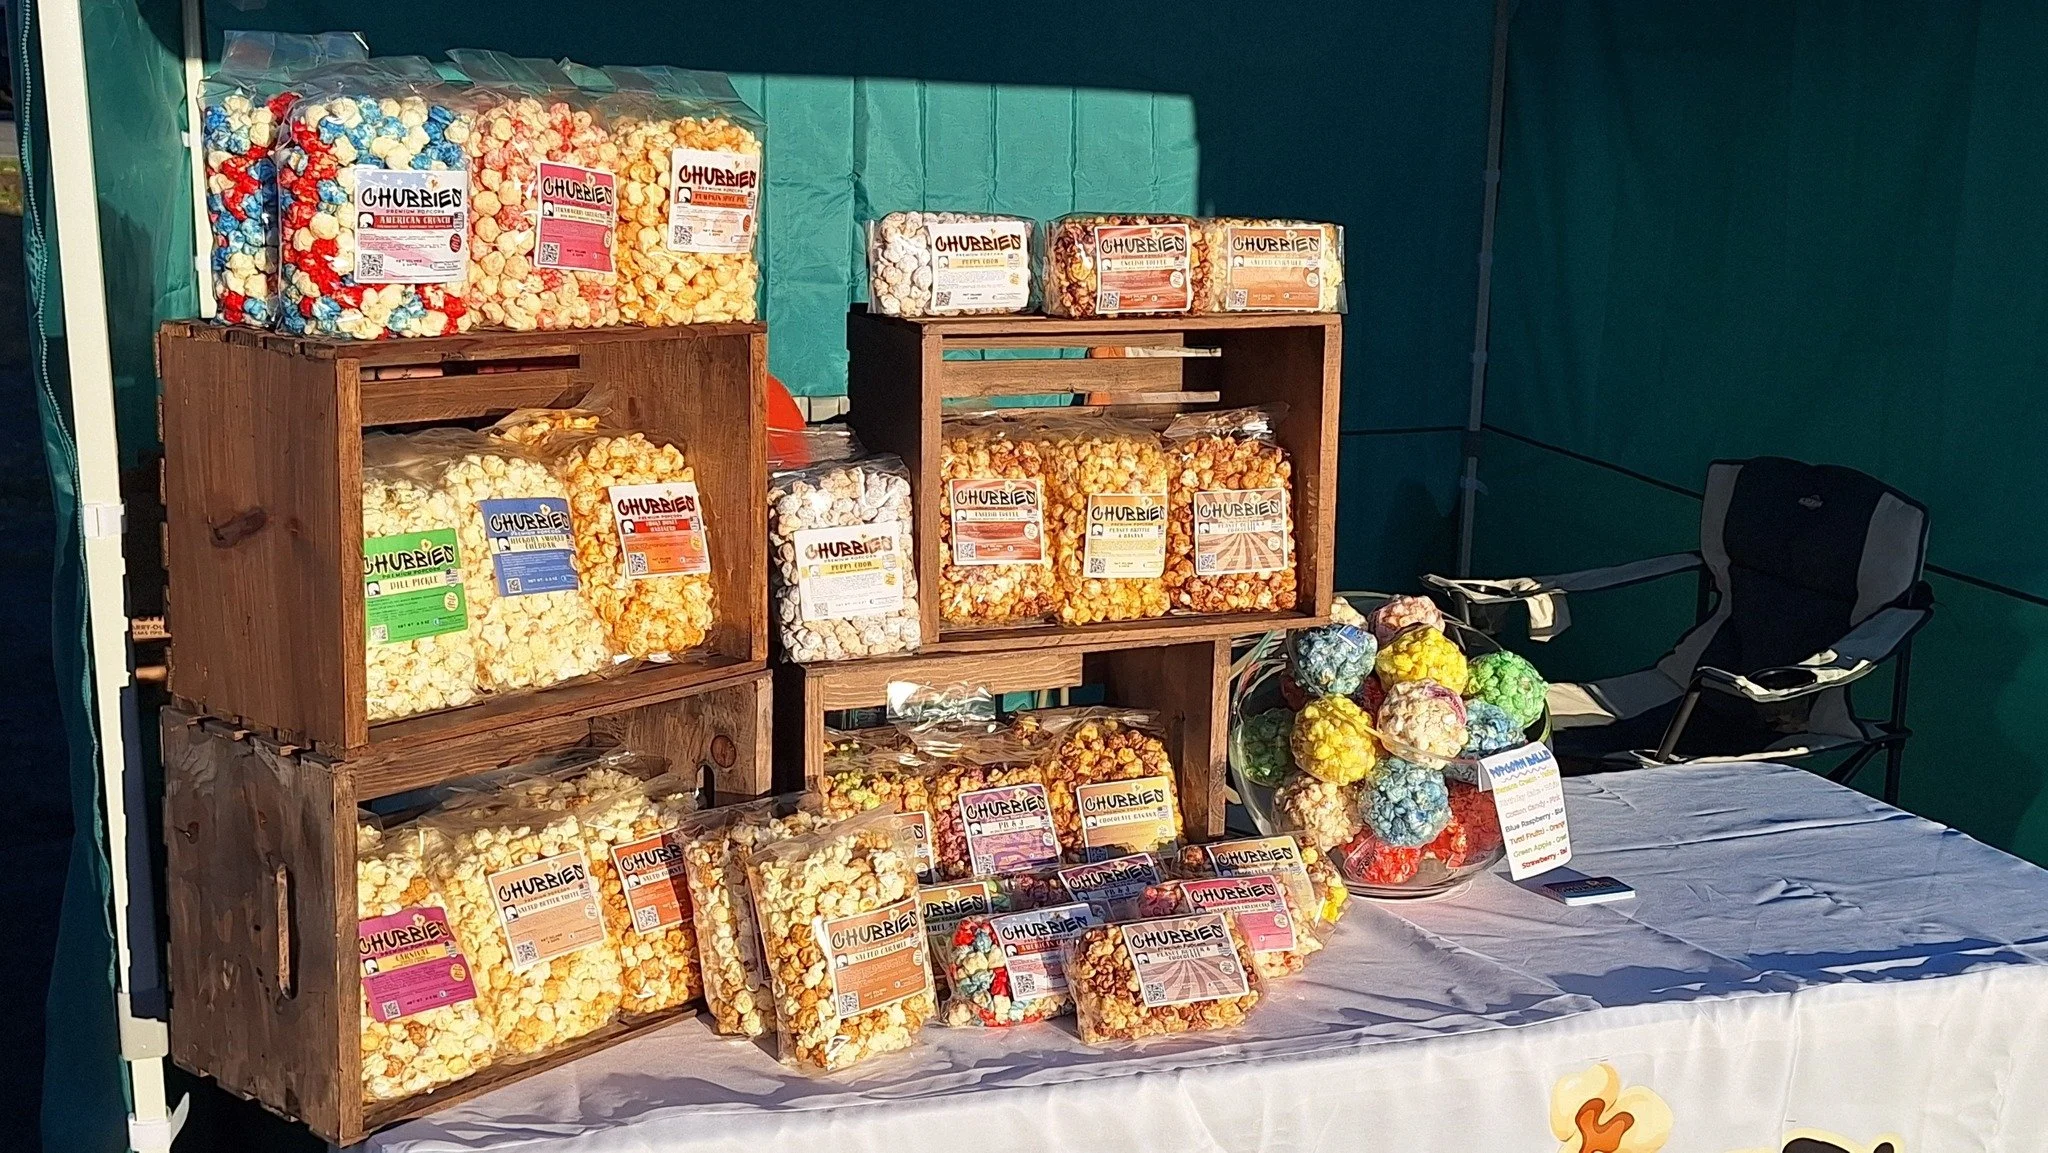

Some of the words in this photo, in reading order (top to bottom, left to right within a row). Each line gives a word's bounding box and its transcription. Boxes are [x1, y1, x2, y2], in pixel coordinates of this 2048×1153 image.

[679, 164, 757, 189] CHUBBIES
[362, 187, 462, 208] CHUBBIES
[543, 177, 613, 205] CHUBBIES
[695, 193, 722, 201] PUMPKIN
[380, 216, 421, 224] AMERICAN
[423, 216, 451, 224] CRUNCH
[935, 233, 1021, 252] CHUBBIES
[1101, 236, 1184, 254] CHUBBIES
[1232, 236, 1319, 252] CHUBBIES
[617, 495, 695, 516] CHUBBIES
[956, 489, 1036, 505] CHUBBIES
[1091, 505, 1165, 521] CHUBBIES
[1200, 500, 1279, 518] CHUBBIES
[490, 513, 569, 532] CHUBBIES
[511, 537, 539, 545] HICKORY
[525, 541, 557, 550] CHEDDAR
[805, 535, 893, 560] CHUBBIES
[382, 571, 412, 579] PREMIUM
[413, 567, 441, 575] POPCORN
[390, 580, 409, 590] DILL
[412, 576, 438, 587] PICKLE
[1488, 758, 1528, 779] POPCORN
[1525, 750, 1552, 767] BALLS
[966, 795, 1046, 819] CHUBBIES
[1085, 789, 1164, 811] CHUBBIES
[1505, 807, 1528, 818] Cotton
[1528, 800, 1546, 811] Candy
[1505, 824, 1520, 832] Blue
[1521, 813, 1551, 827] Raspberry
[1509, 835, 1525, 845] Tutti
[1526, 827, 1545, 839] Frutti
[1217, 847, 1294, 865] CHUBBIES
[1513, 847, 1533, 858] Green
[1534, 841, 1552, 851] Apple
[1521, 853, 1557, 869] Strawberry
[498, 863, 585, 902] CHUBBIES
[1069, 863, 1153, 889] CHUBBIES
[517, 903, 539, 914] SALTED
[539, 897, 560, 908] BUTTER
[561, 891, 580, 902] TOFFEE
[1191, 883, 1276, 903] CHUBBIES
[832, 910, 917, 949] CHUBBIES
[1002, 915, 1088, 940] CHUBBIES
[1131, 924, 1224, 949] CHUBBIES
[395, 948, 430, 961] CARNIVAL
[855, 950, 879, 961] SALTED
[880, 941, 907, 955] CARAMEL
[1021, 940, 1055, 950] AMERICAN
